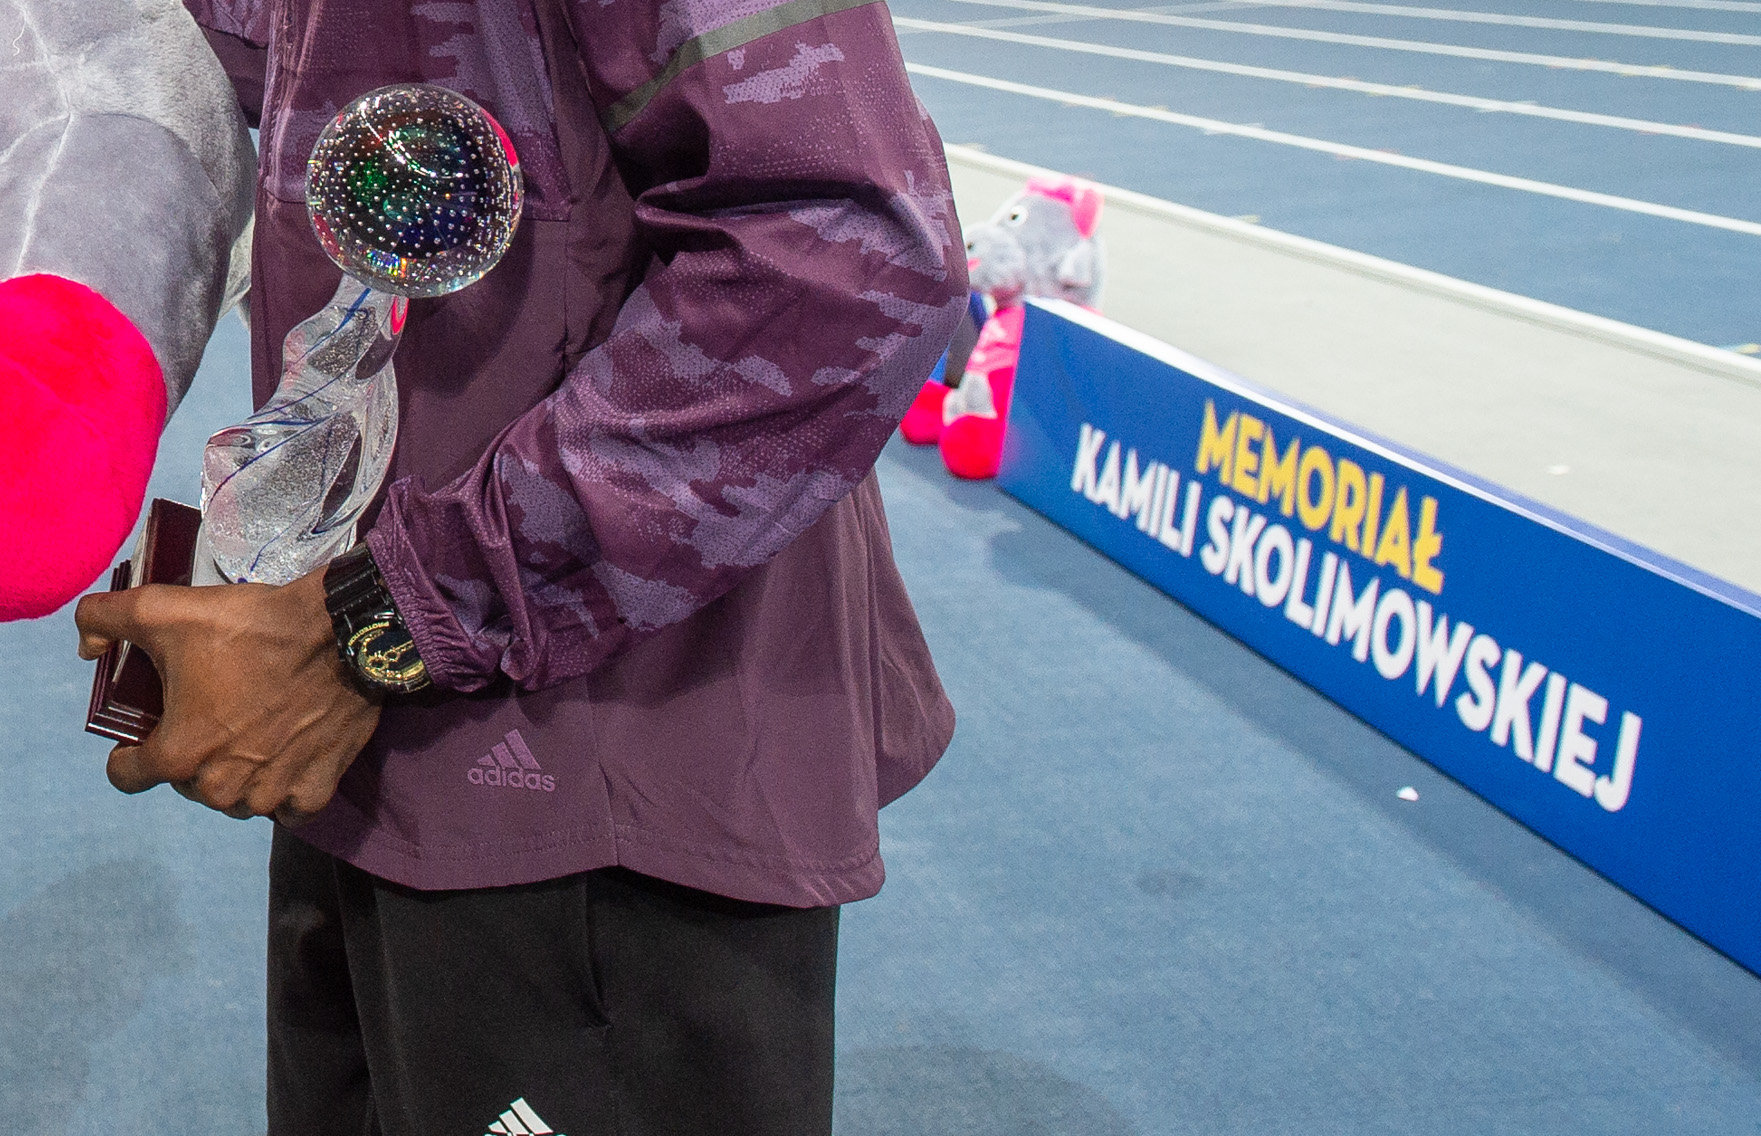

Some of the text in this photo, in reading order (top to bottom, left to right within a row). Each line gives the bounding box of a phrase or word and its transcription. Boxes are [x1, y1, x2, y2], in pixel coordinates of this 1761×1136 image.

[1196, 400, 1444, 594] MEMORIAŁ
[347, 620, 390, 647] PROTECTION
[1071, 422, 1643, 813] KAMILI SKOLIMOWSKIEJ
[467, 764, 556, 793] adidas
